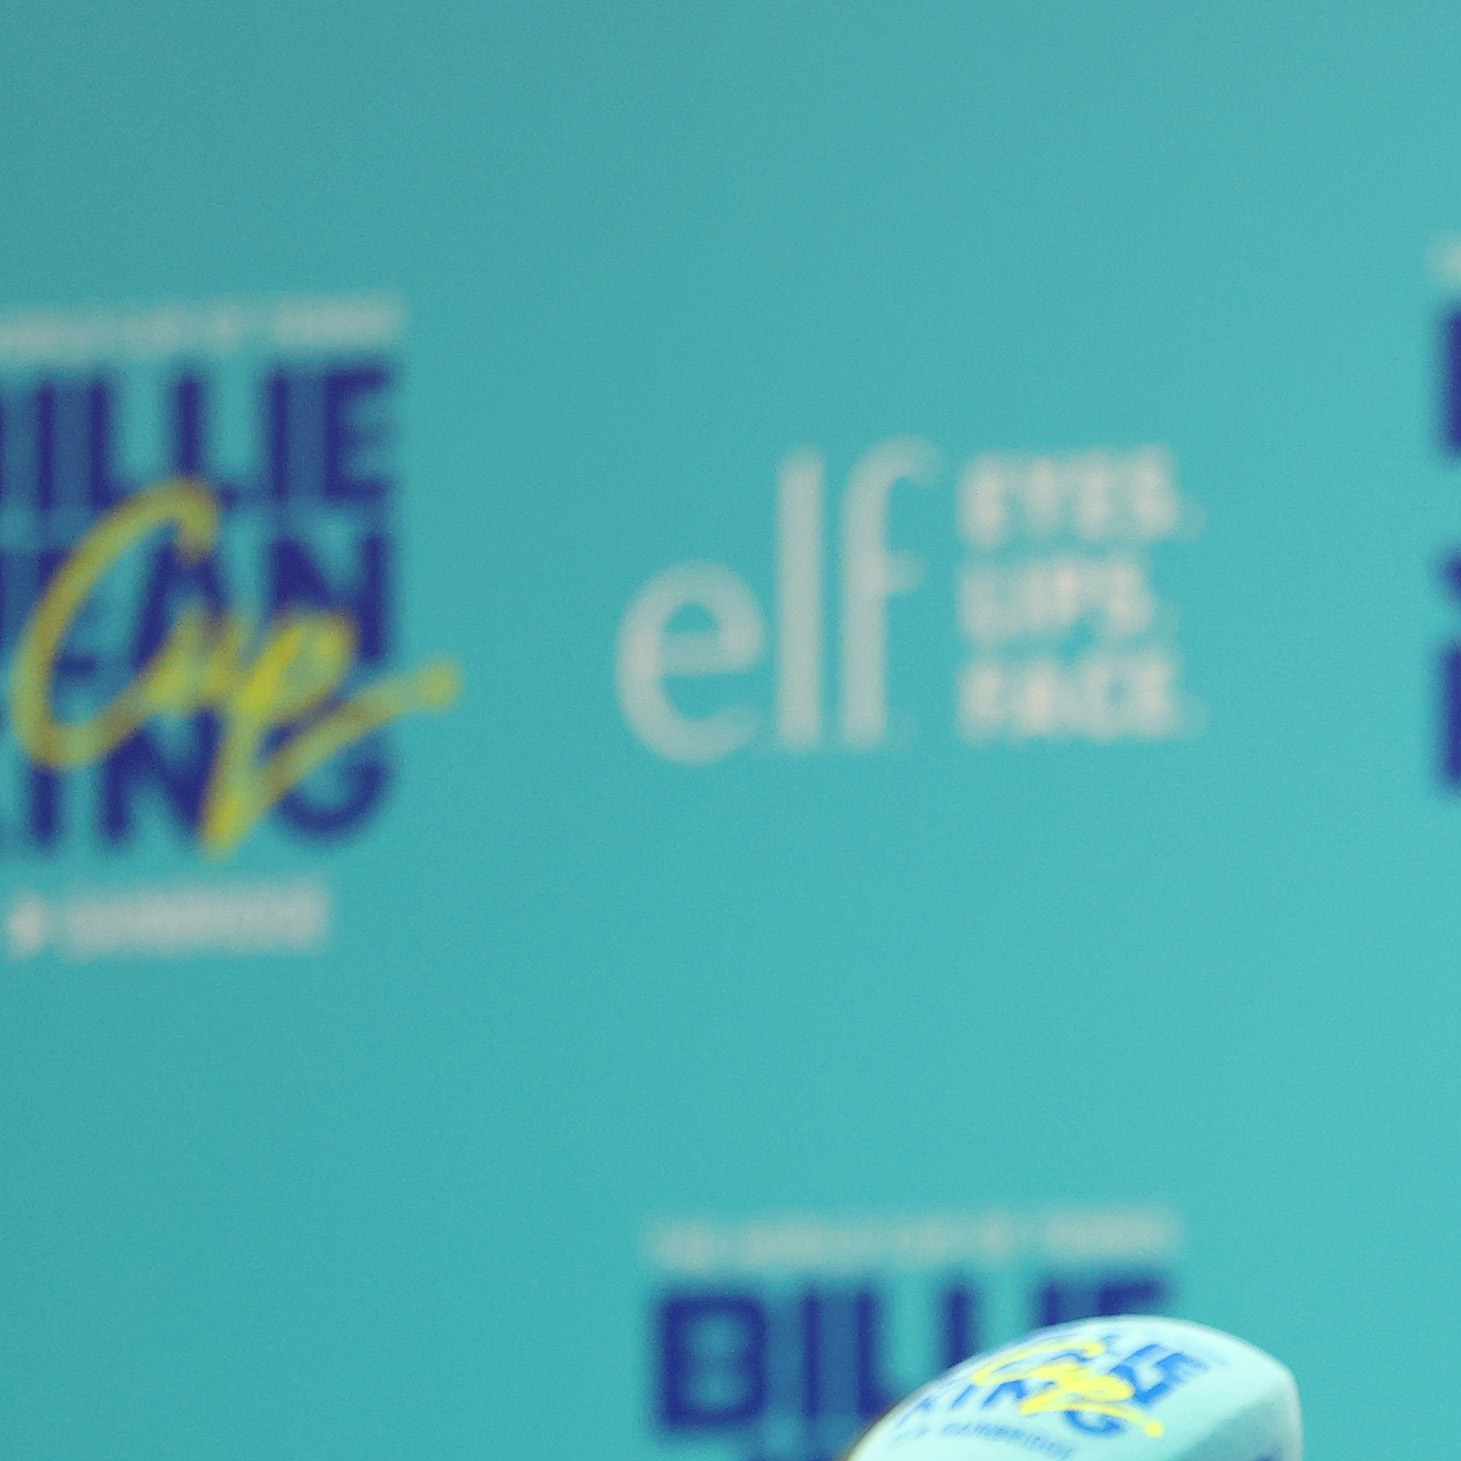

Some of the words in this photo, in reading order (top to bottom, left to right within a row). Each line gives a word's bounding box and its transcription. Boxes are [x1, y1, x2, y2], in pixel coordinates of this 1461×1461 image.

[0, 365, 402, 508] ILLIE
[0, 525, 398, 672] EAN
[10, 478, 462, 862] Cup
